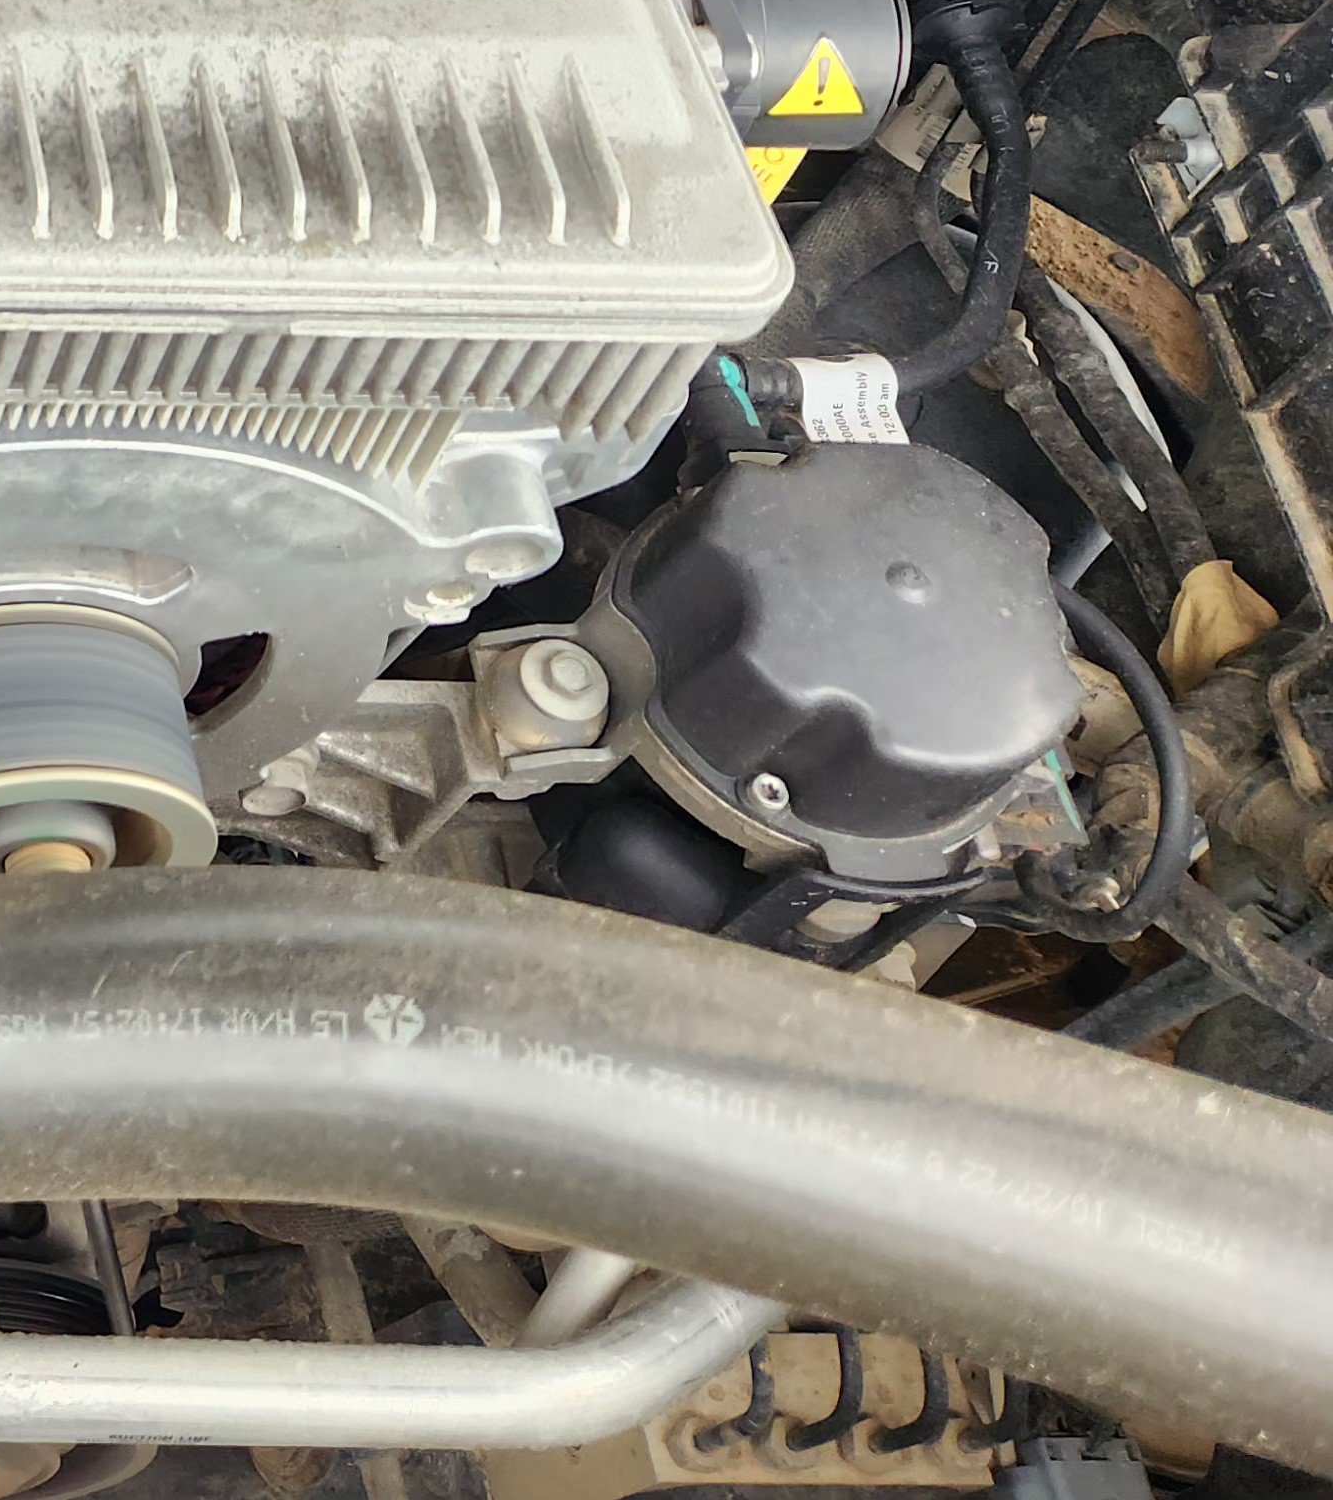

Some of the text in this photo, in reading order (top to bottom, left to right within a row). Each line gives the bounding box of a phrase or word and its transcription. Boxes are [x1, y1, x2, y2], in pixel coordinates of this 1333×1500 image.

[855, 371, 873, 428] Assembly
[877, 383, 898, 435] 12:03 am
[811, 418, 830, 442] 362
